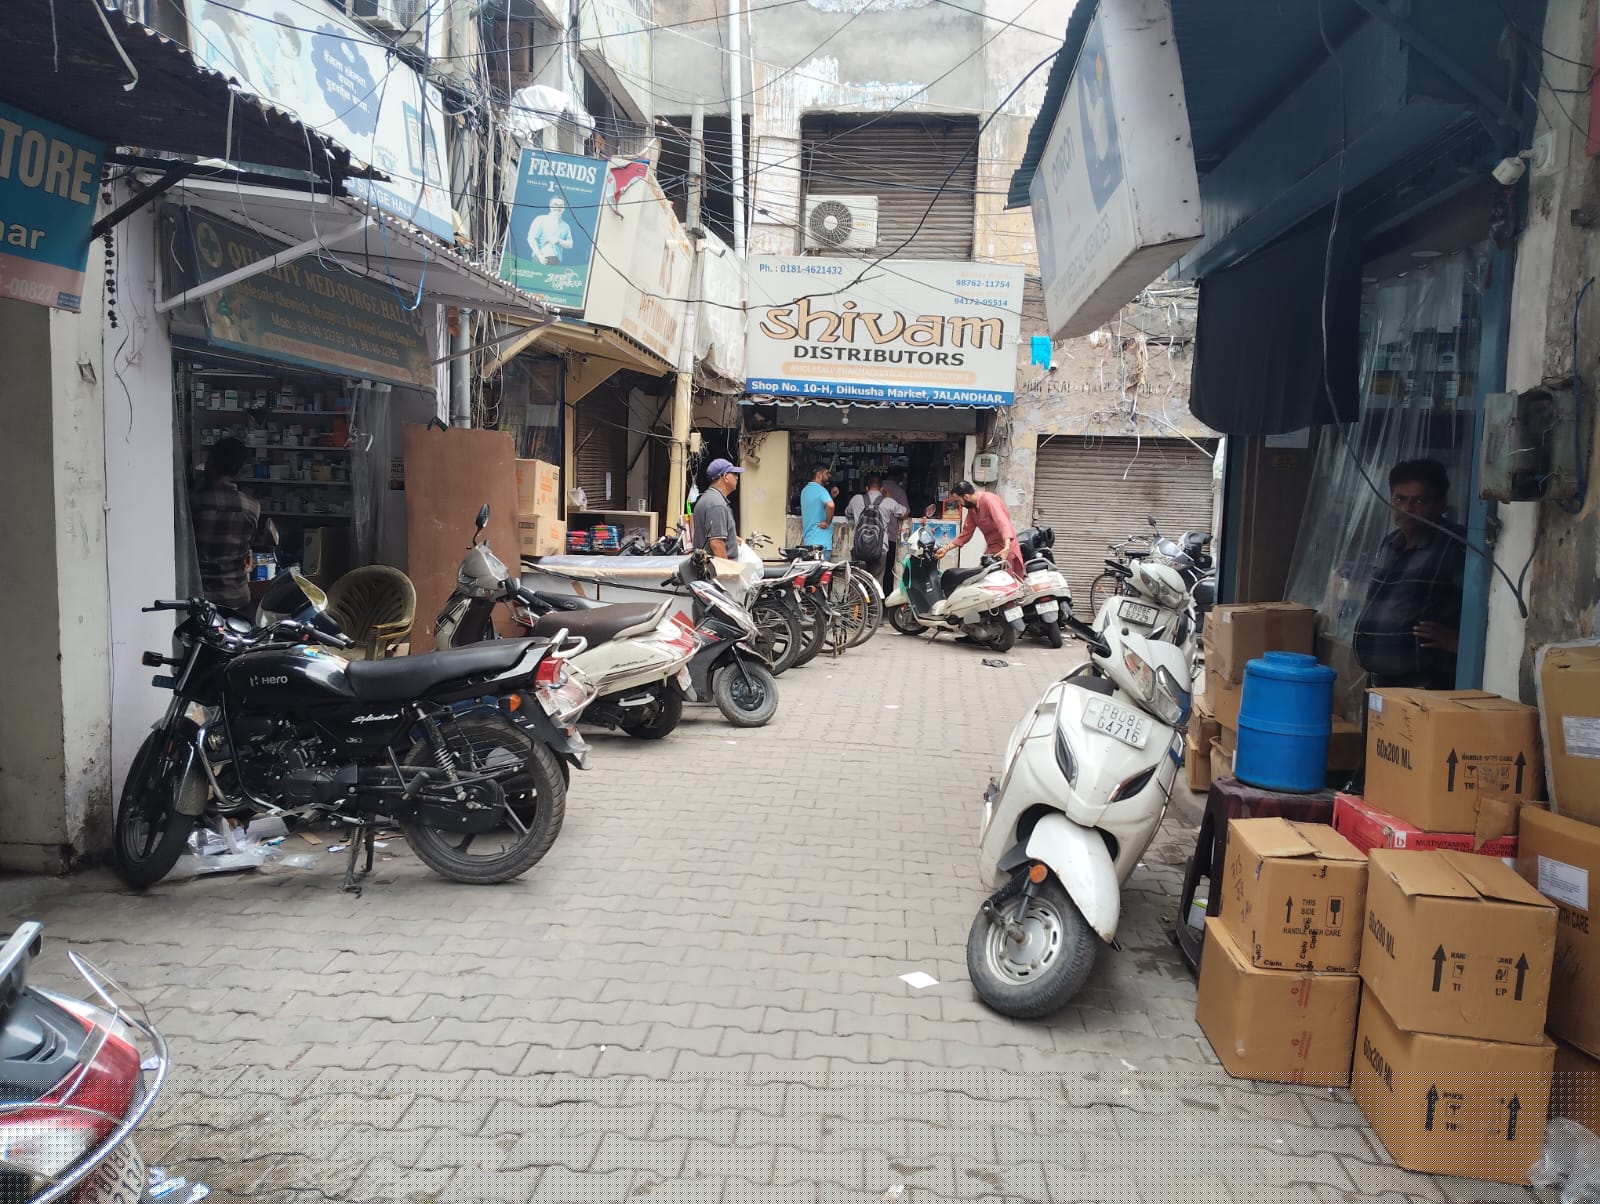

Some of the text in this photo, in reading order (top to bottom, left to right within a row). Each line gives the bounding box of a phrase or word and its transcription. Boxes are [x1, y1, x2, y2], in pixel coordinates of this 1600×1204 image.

[528, 157, 597, 184] FRIENDS
[0, 222, 45, 250] ar
[759, 263, 772, 273] Ph.
[780, 264, 843, 275] 0181-4621432
[0, 275, 55, 301] -00827
[955, 280, 1010, 288] 98762-11754
[794, 345, 965, 366] DISTRIBUTORS
[751, 381, 1006, 404] Shop No. 10-H, Dilkusha Market, JALANDHAR.
[1098, 716, 1140, 743] G4716
[1376, 738, 1413, 770] 60x200 ML
[1396, 836, 1405, 847] b
[1302, 898, 1316, 906] THIS
[1283, 927, 1308, 935] HANDLE
[1324, 929, 1342, 937] CARE
[1571, 910, 1590, 935] CARE
[1299, 941, 1308, 960] Cipla
[1386, 931, 1396, 960] ML
[1451, 952, 1466, 960] HAN
[1495, 988, 1507, 997] UP
